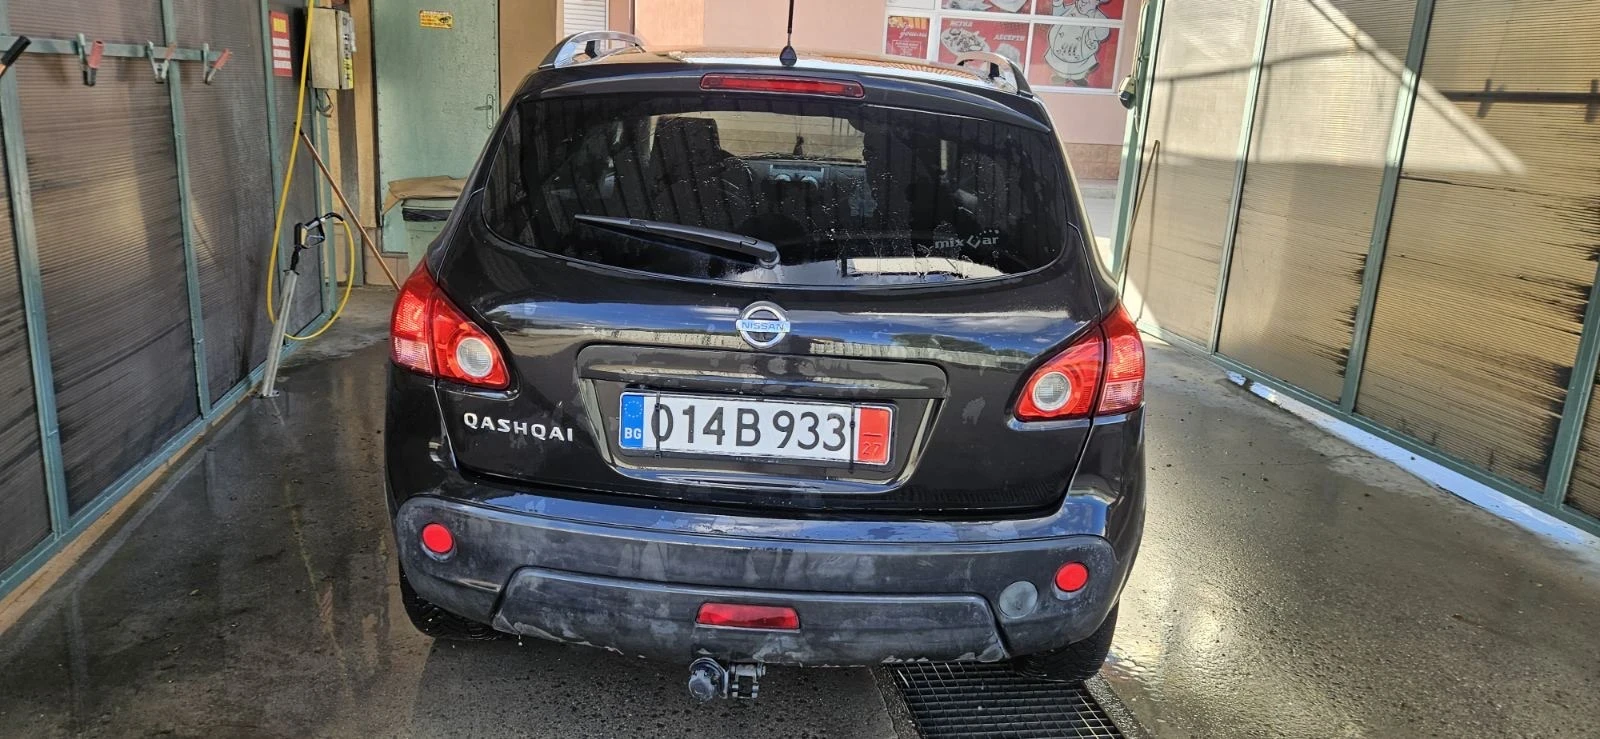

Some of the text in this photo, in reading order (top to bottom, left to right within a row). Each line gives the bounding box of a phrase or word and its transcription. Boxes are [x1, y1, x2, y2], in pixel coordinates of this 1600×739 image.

[741, 322, 784, 331] NISSAN
[463, 412, 573, 442] QASHQAI
[624, 427, 642, 440] BG
[863, 442, 881, 456] 27
